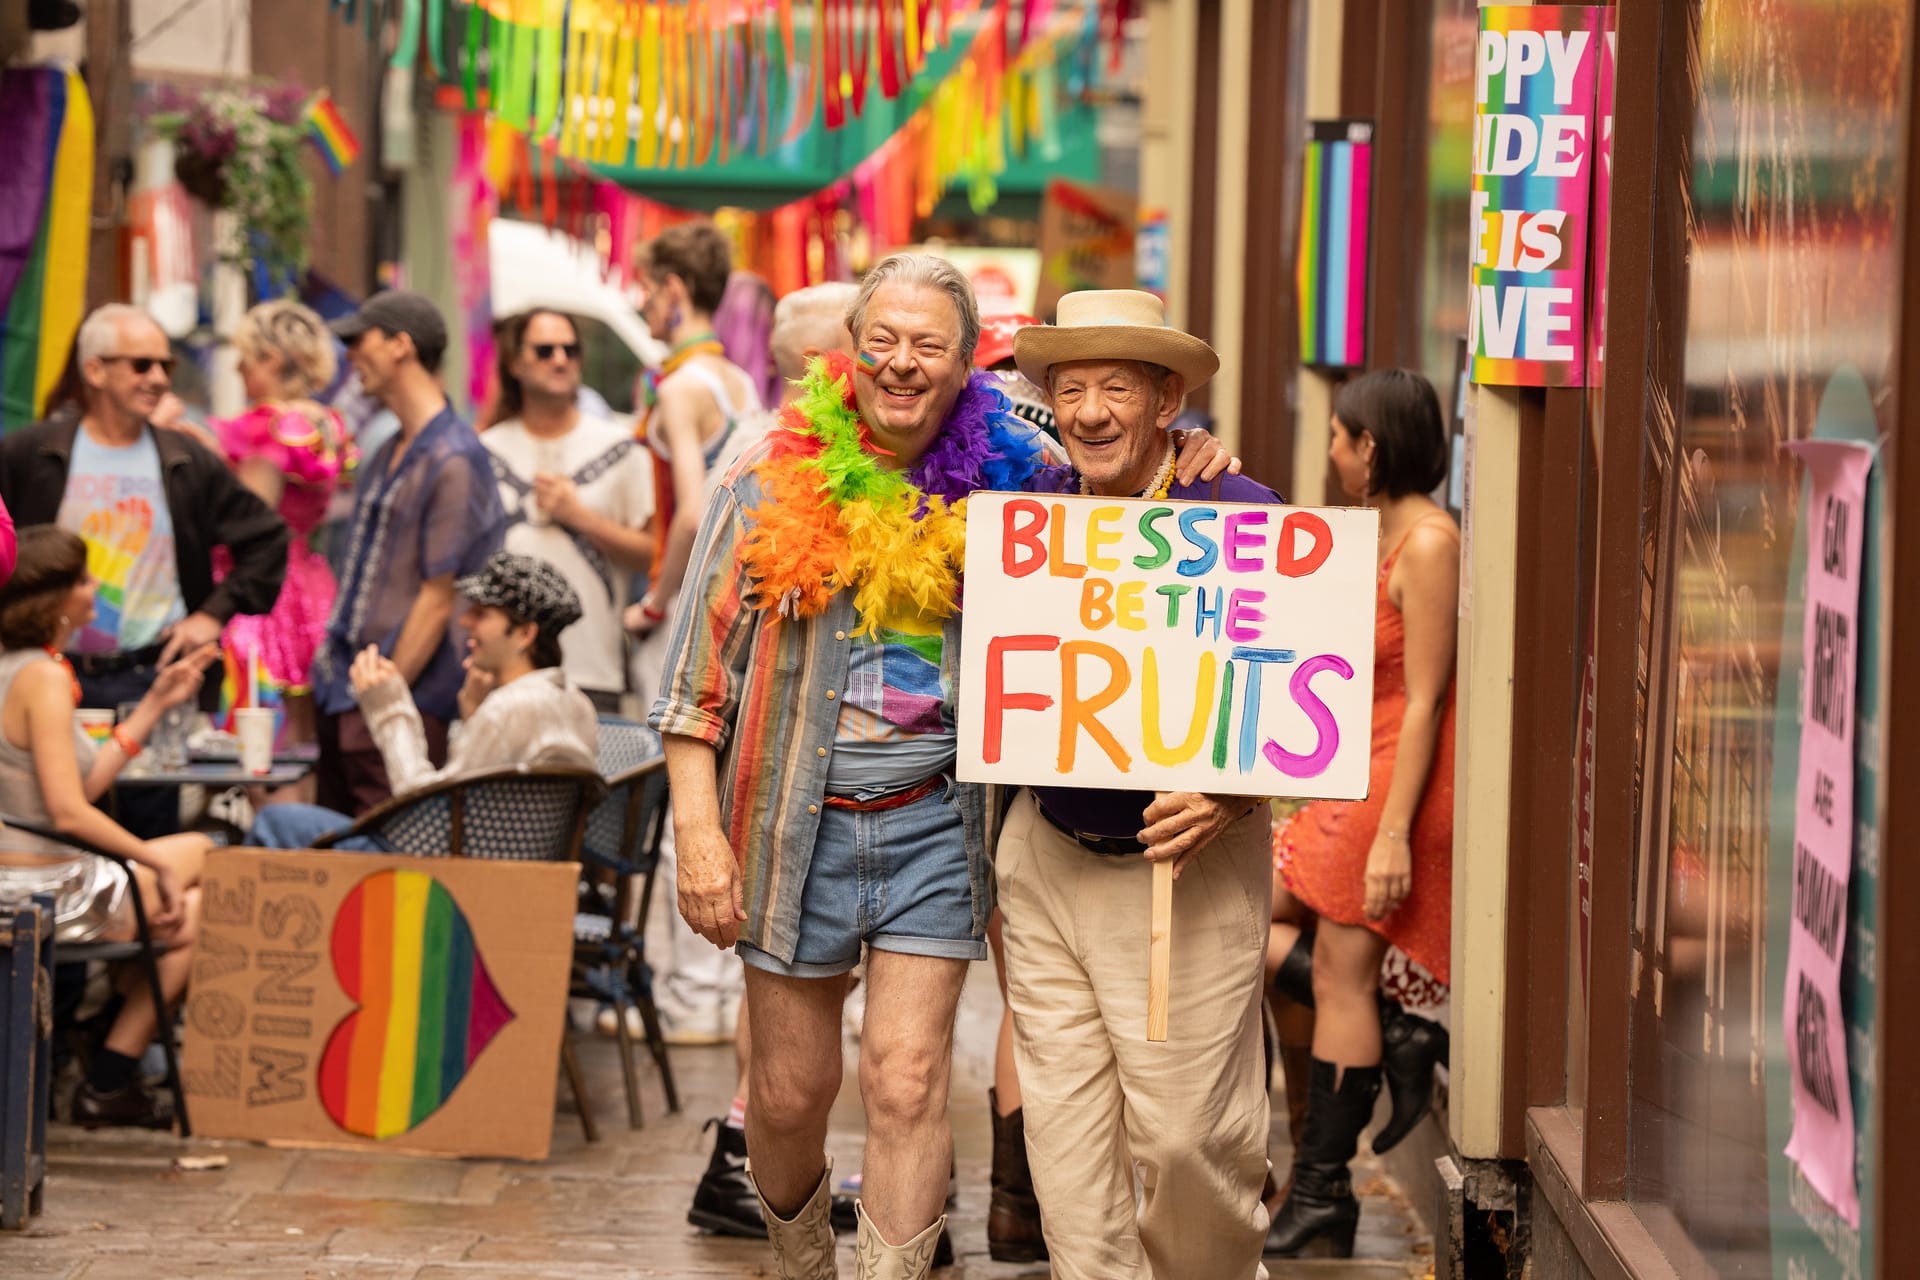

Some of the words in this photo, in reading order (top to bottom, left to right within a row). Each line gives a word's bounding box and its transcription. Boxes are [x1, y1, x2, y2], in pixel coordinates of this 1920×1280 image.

[1494, 209, 1567, 273] IS
[1002, 499, 1334, 579] BLESSED
[1823, 493, 1850, 580] GAY
[1079, 578, 1148, 632] BE
[1155, 584, 1268, 643] THE
[1811, 601, 1849, 741] RIGHTS
[983, 635, 1355, 779] FRUITS
[1812, 768, 1835, 828] ARE
[1796, 840, 1848, 965] HUMAN
[184, 876, 256, 1099] LOVE
[246, 860, 329, 1109] WINS!
[1796, 969, 1841, 1123] RIGHTS
